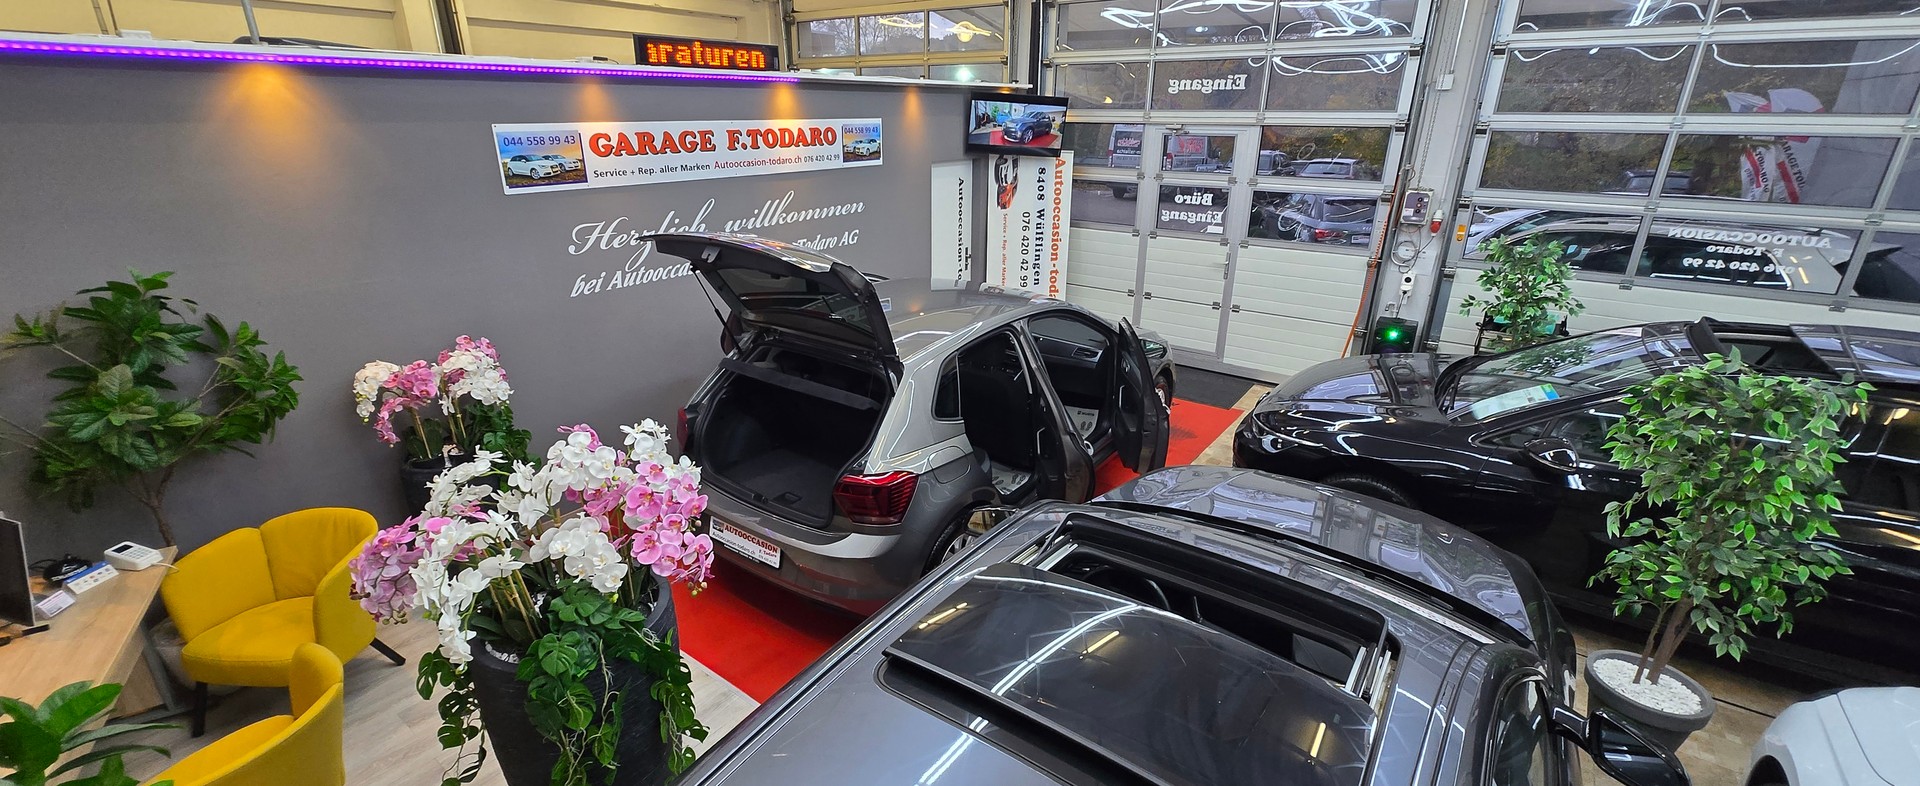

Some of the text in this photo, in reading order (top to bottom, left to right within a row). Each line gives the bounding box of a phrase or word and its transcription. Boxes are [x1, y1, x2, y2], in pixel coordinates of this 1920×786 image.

[503, 135, 576, 147] 044 558 99 43
[588, 126, 838, 158] GARAGE F.TODARO
[844, 126, 854, 134] 044
[854, 126, 865, 134] 558
[593, 167, 628, 178] Service
[638, 167, 657, 178] Rep.
[659, 165, 679, 174] aller
[680, 163, 711, 173] Marken
[714, 155, 802, 170] Autooccasion-todaro.ch
[803, 155, 814, 163] 076
[815, 154, 825, 162] 420
[825, 154, 833, 162] 42
[832, 153, 840, 161] 99
[724, 190, 865, 233] willkommen
[1032, 167, 1047, 286] 8408 Wülflingen
[570, 272, 607, 298] bei
[838, 229, 859, 247] AG
[1019, 211, 1031, 288] 076 420 42 99
[724, 524, 779, 554] AUTOOCCASION
